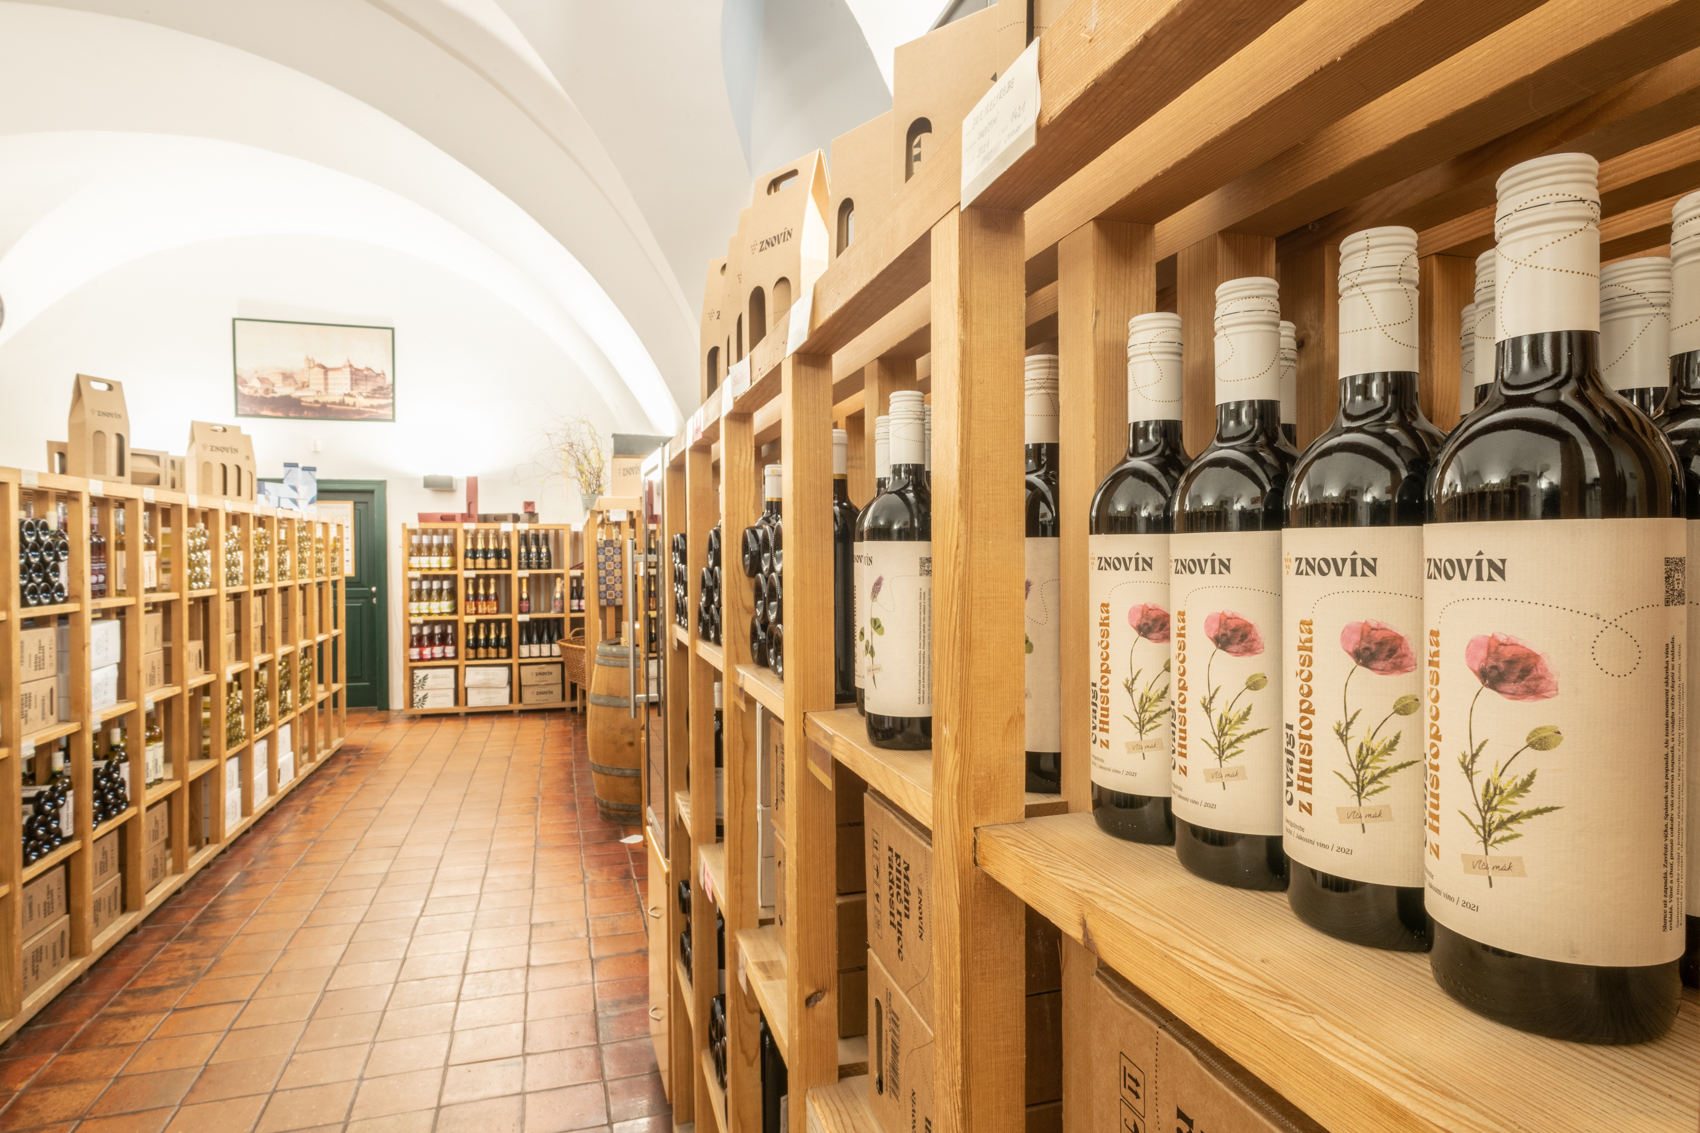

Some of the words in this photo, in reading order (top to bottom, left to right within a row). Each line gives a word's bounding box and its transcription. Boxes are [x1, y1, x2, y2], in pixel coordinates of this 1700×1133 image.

[759, 227, 793, 252] ZNOVÍN
[97, 410, 122, 419] ZNOVÍN
[210, 445, 239, 454] ZNOVÍN
[1097, 552, 1153, 571] ZNOVÍN
[1174, 552, 1231, 575] ZNOVÍN
[1295, 550, 1378, 577] ZNOVÍN
[1427, 550, 1507, 582] ZNOVÍN
[1098, 602, 1111, 734] Hustopečska
[1175, 610, 1188, 760] Hustopečska
[1296, 618, 1315, 796] Hustopečska
[1427, 628, 1442, 836] Hustopečska
[1365, 810, 1382, 818] mák
[1316, 840, 1330, 849] víno
[1336, 846, 1353, 855] 2021
[895, 852, 904, 903] plné
[1492, 862, 1512, 871] mák
[888, 845, 896, 930] radosti
[903, 859, 912, 920] Mám
[1443, 892, 1455, 902] víno
[1461, 900, 1479, 912] 2021
